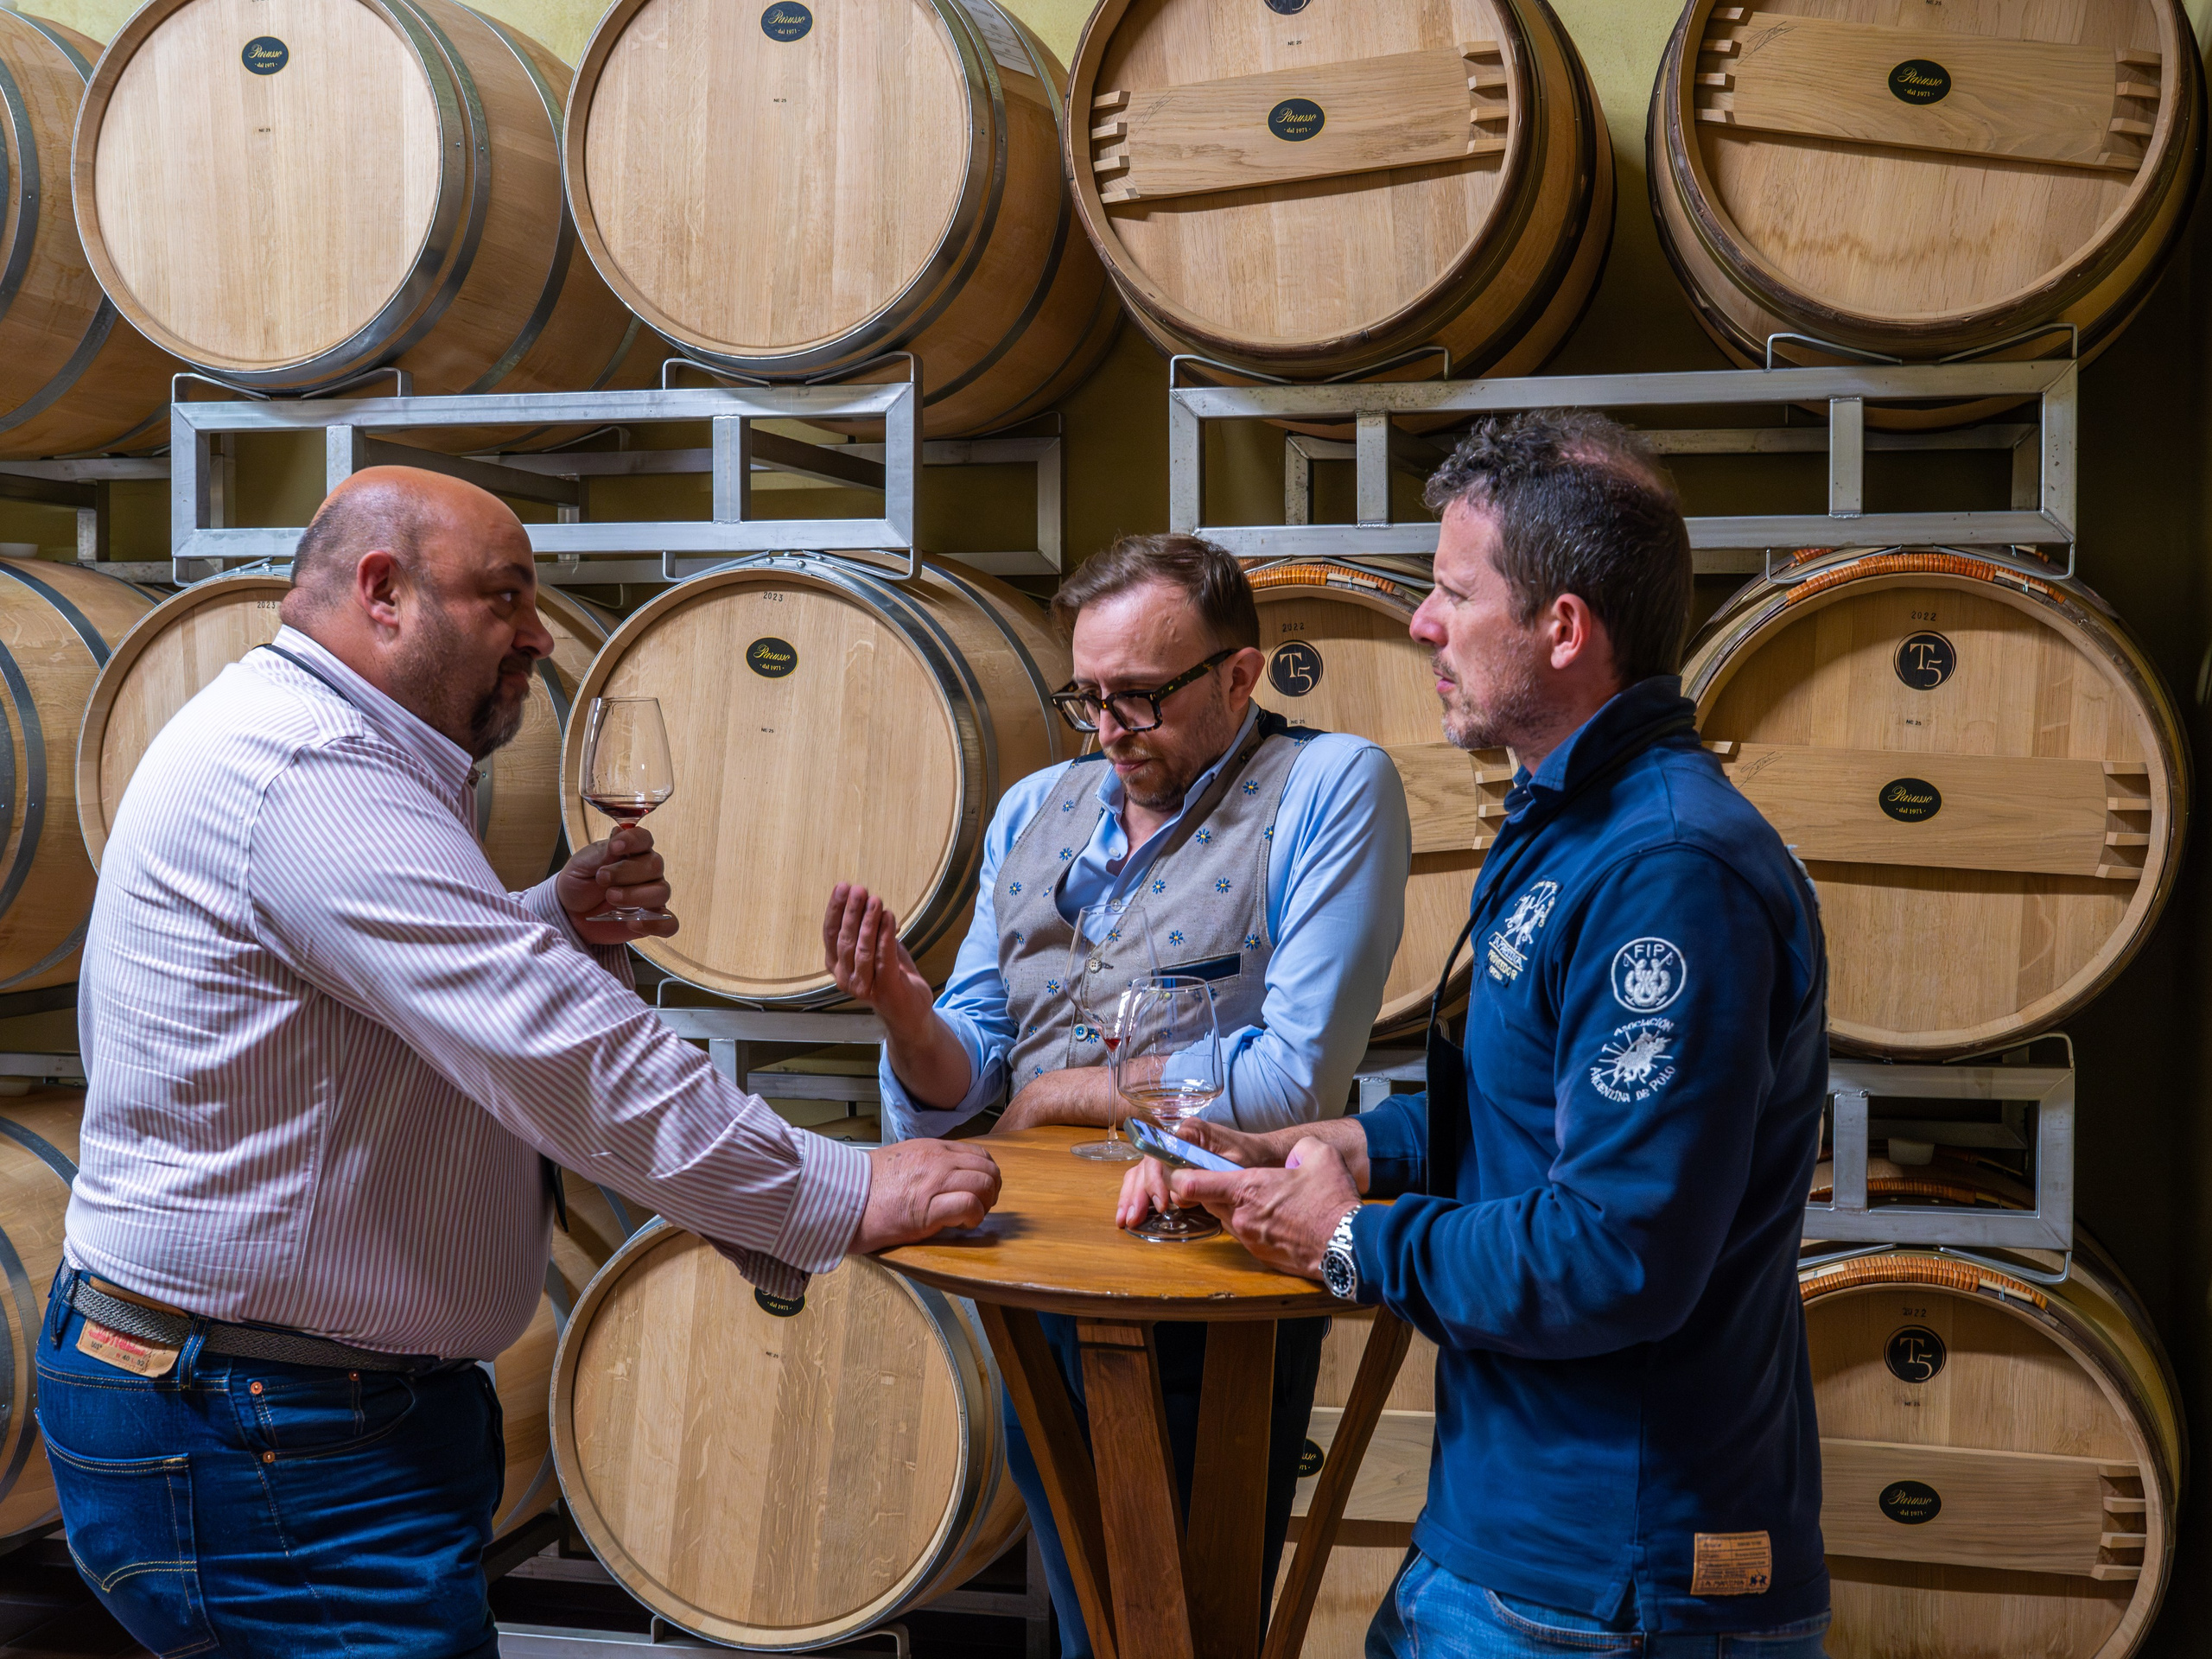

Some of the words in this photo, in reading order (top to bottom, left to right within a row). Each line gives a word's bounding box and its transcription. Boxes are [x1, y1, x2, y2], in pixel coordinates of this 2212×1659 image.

[768, 10, 805, 24] Parusso
[1897, 67, 1942, 86] Parusso
[1275, 107, 1317, 124] Parusso
[763, 591, 784, 602] 2023
[257, 601, 276, 609] 2023
[1910, 610, 1936, 621] 2022
[753, 644, 791, 661] Parusso
[1887, 785, 1933, 804] Parusso
[1634, 944, 1665, 958] FIP
[1649, 1065, 1675, 1092] POLO
[1887, 1489, 1932, 1505] Parusso
